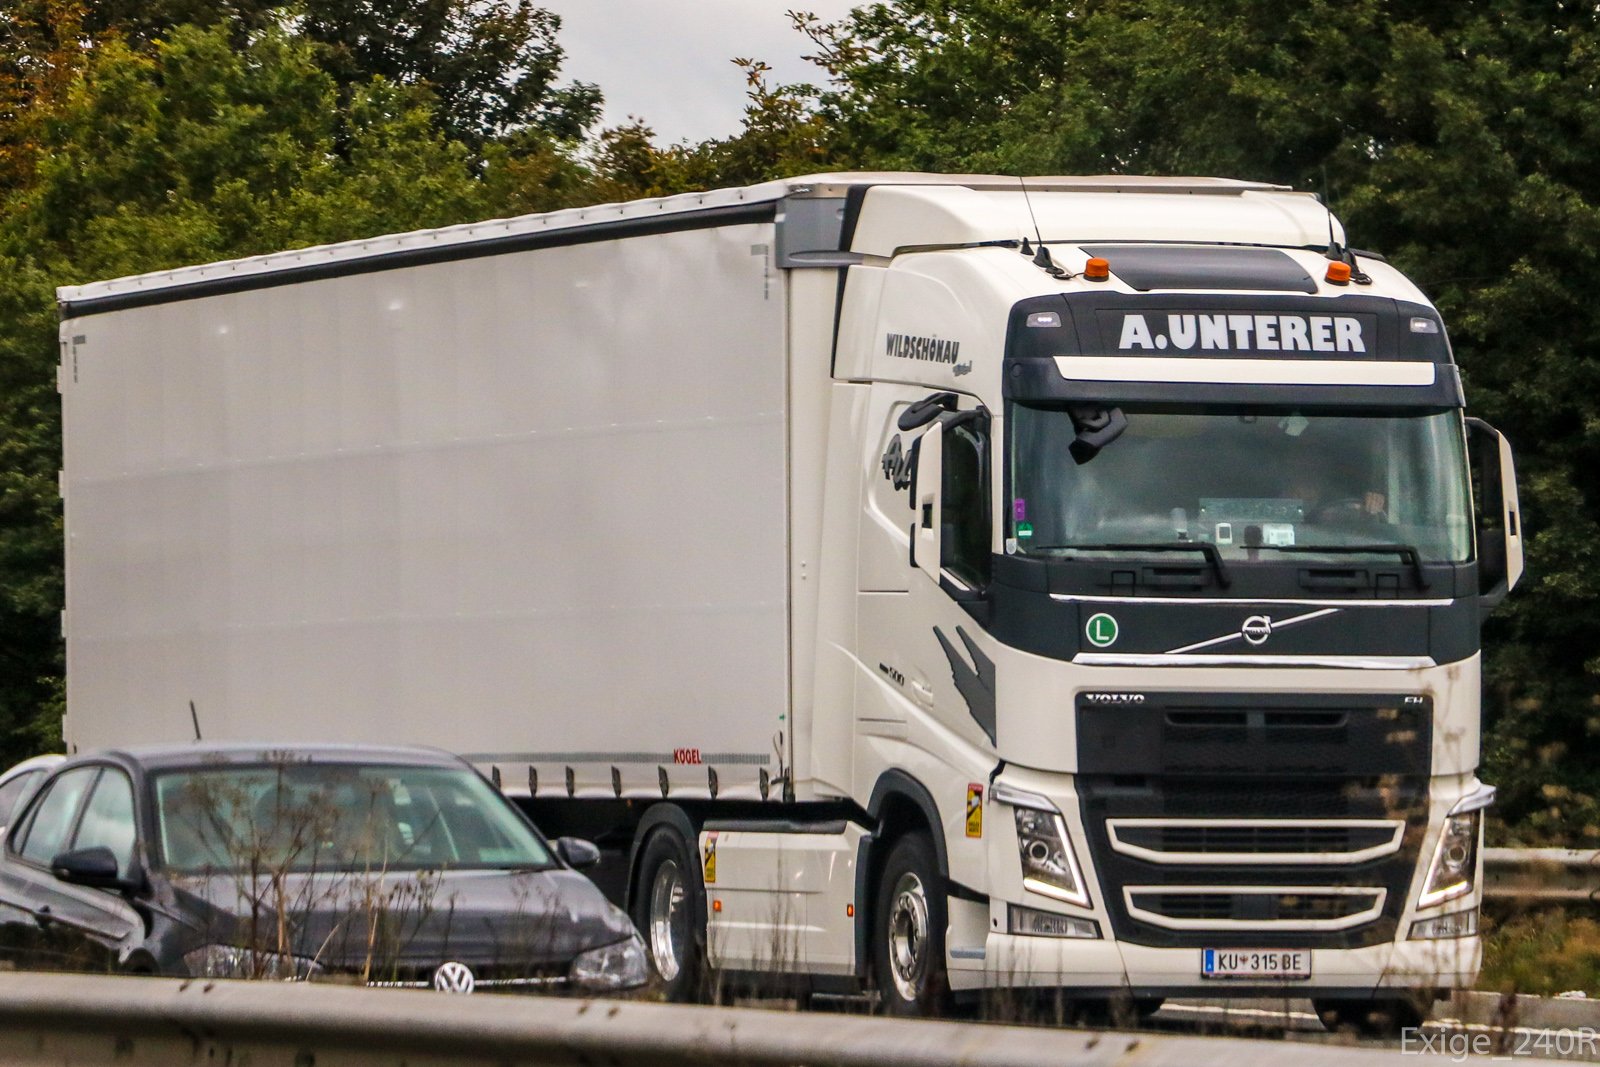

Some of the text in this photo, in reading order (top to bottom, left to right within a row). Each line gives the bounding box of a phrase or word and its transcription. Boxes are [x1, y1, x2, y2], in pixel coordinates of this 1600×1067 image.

[1119, 314, 1366, 353] A.UNTERER
[886, 333, 960, 364] WILDSCHÖNAU
[1096, 619, 1110, 640] L
[1085, 693, 1145, 704] VOLVO
[1218, 953, 1238, 970] KU
